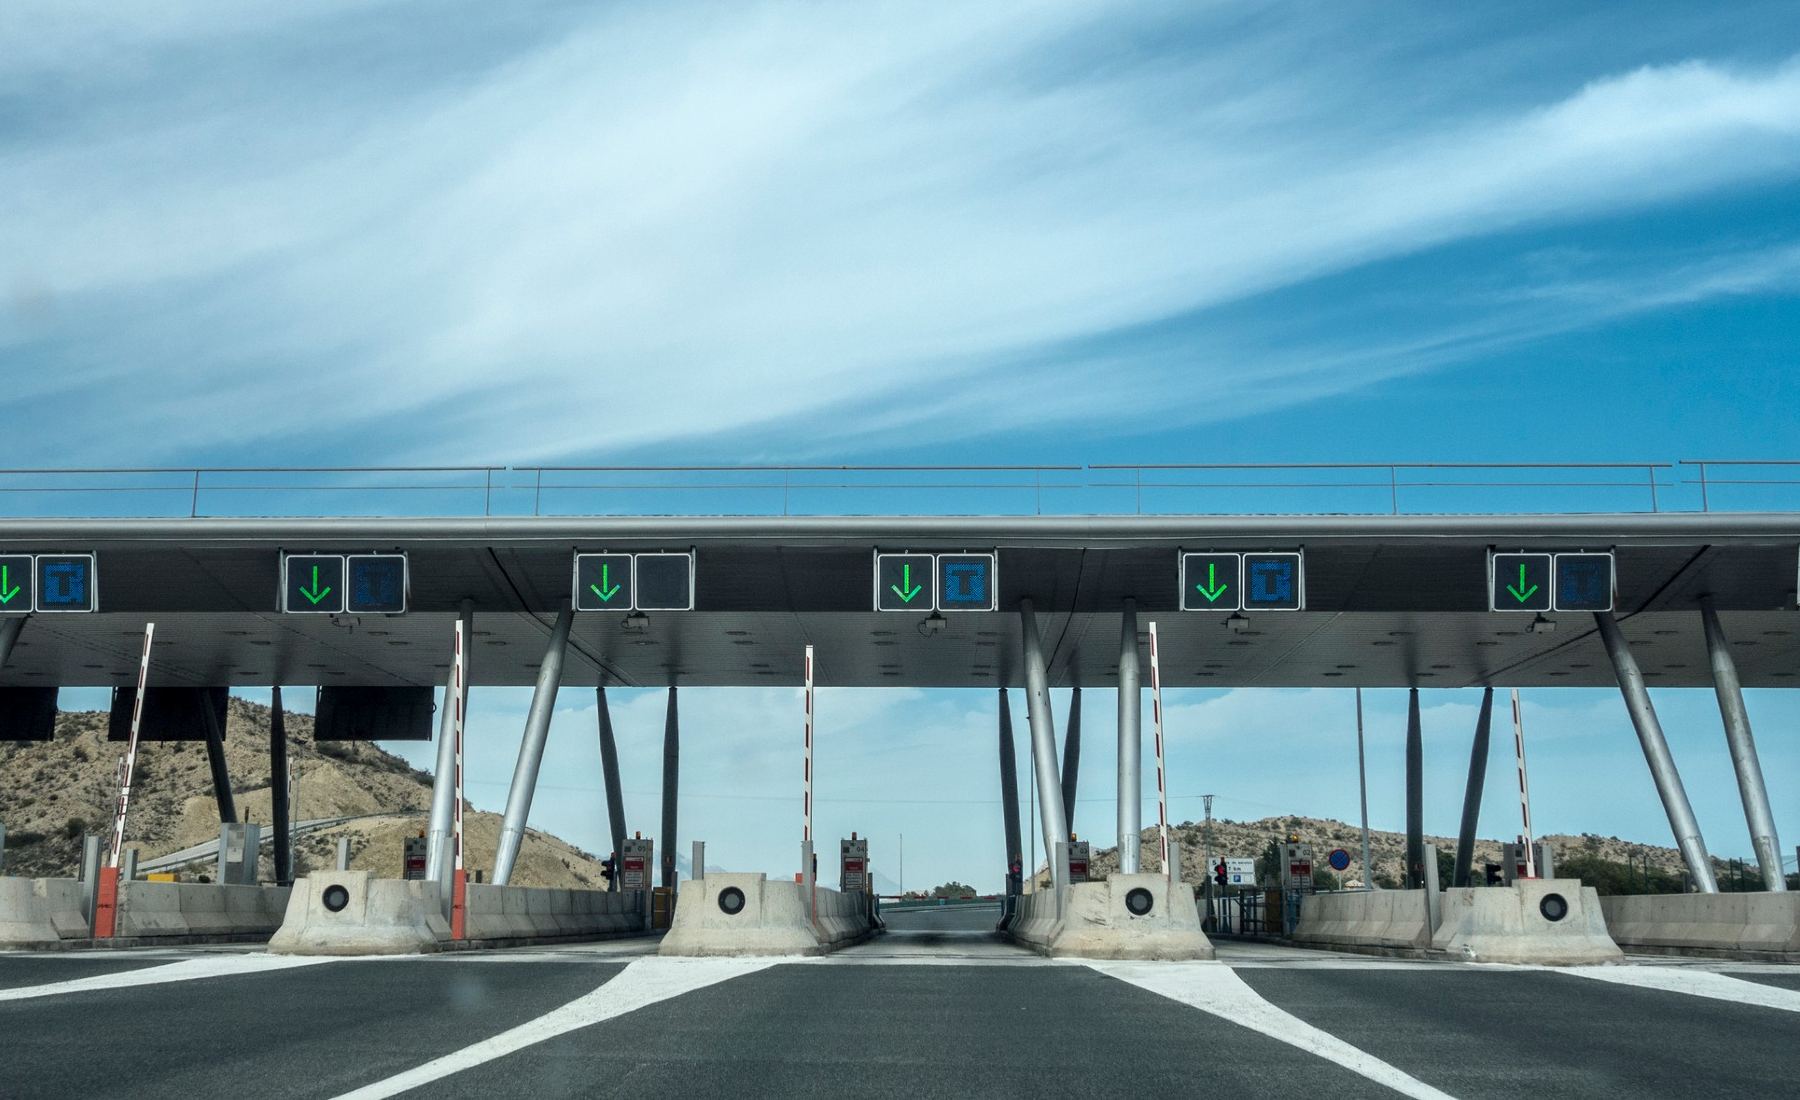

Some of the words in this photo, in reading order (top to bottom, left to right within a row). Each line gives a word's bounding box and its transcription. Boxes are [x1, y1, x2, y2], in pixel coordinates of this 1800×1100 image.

[49, 570, 77, 597] T
[951, 570, 979, 595] T
[1256, 570, 1284, 596] T
